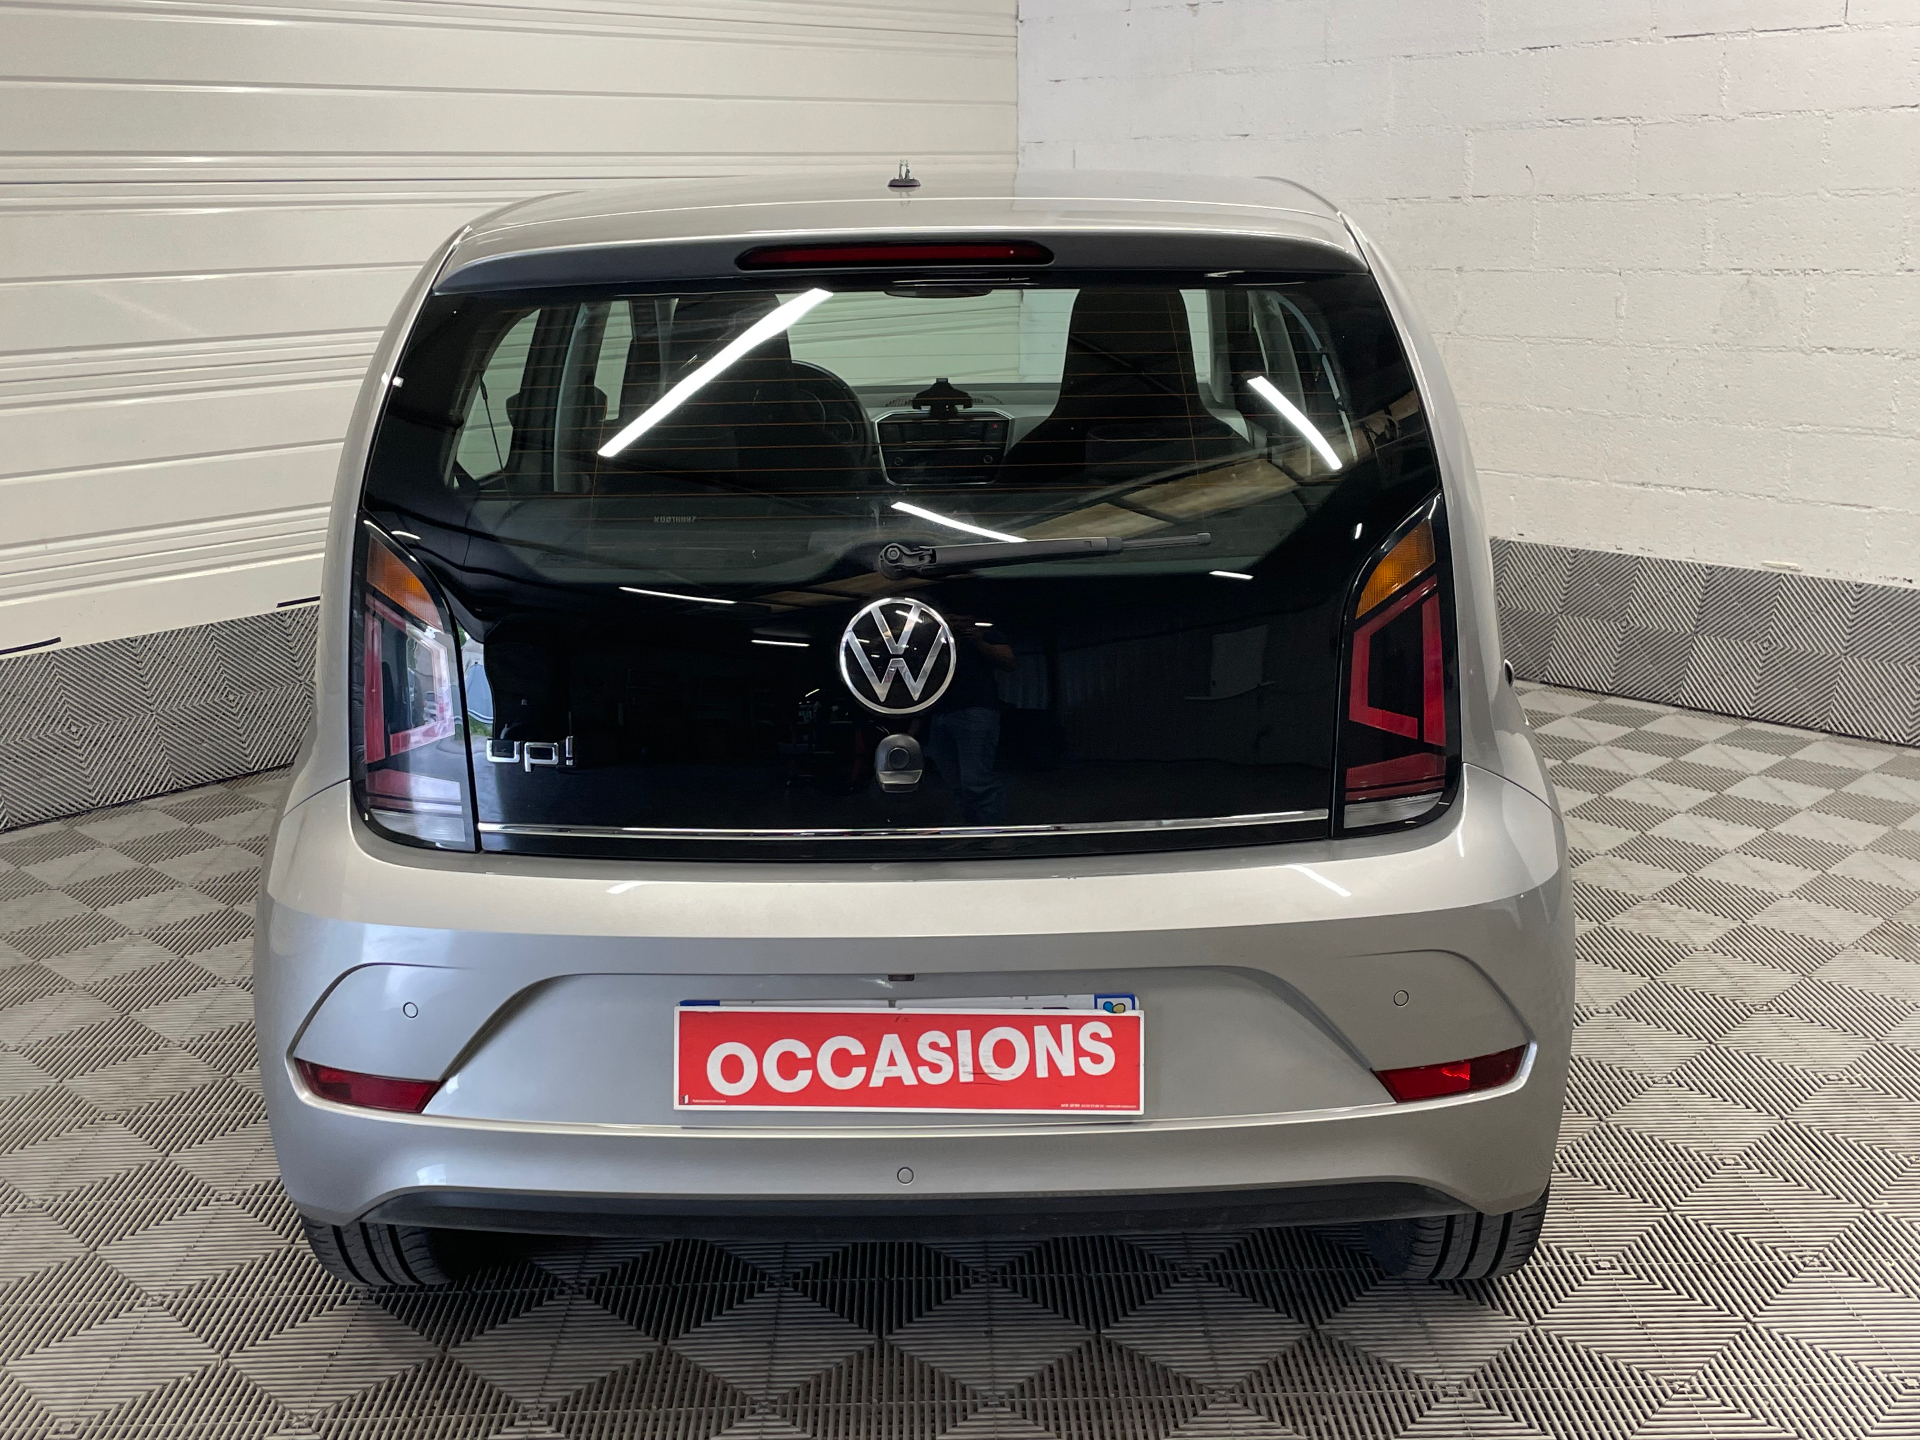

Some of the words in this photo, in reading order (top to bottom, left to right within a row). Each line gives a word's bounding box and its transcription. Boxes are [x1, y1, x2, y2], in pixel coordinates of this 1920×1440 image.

[845, 602, 950, 704] VW
[486, 735, 574, 773] up!
[705, 1020, 1117, 1097] OCCASIONS
